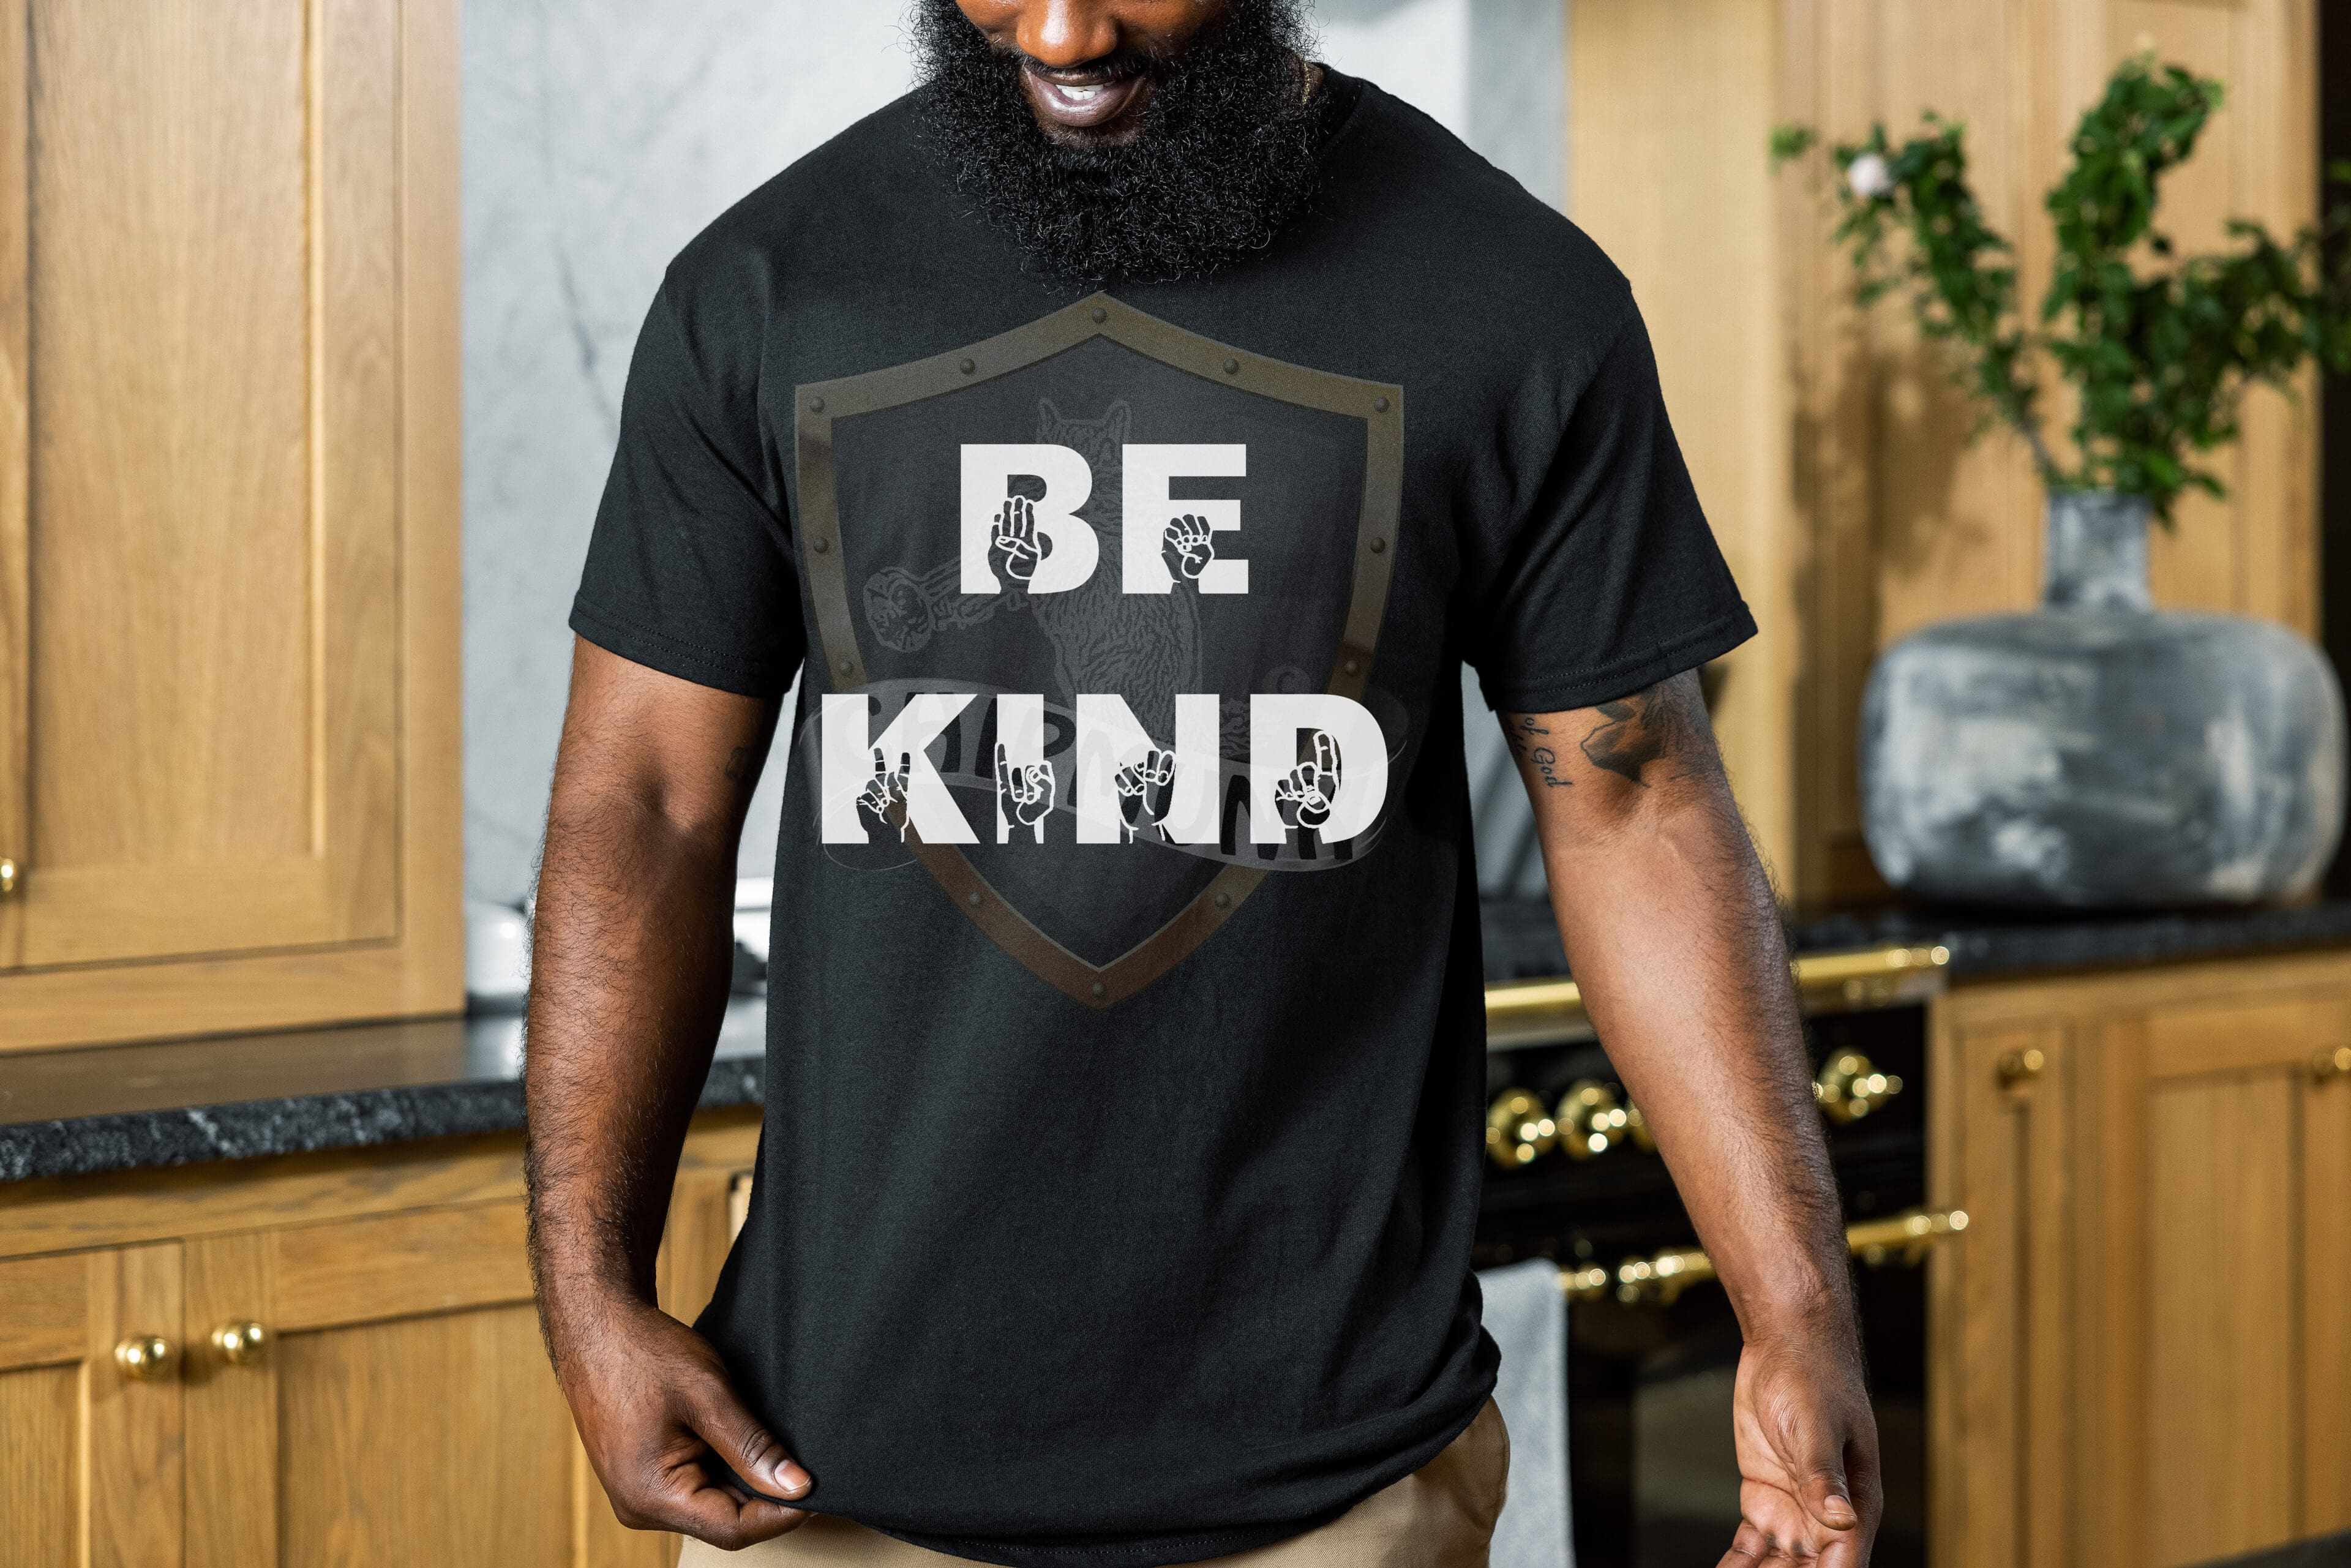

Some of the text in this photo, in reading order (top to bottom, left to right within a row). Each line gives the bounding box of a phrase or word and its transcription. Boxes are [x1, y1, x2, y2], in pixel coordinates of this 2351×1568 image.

[960, 444, 1249, 595] BE
[822, 694, 1389, 844] KIND
[1518, 717, 1573, 787] of God
